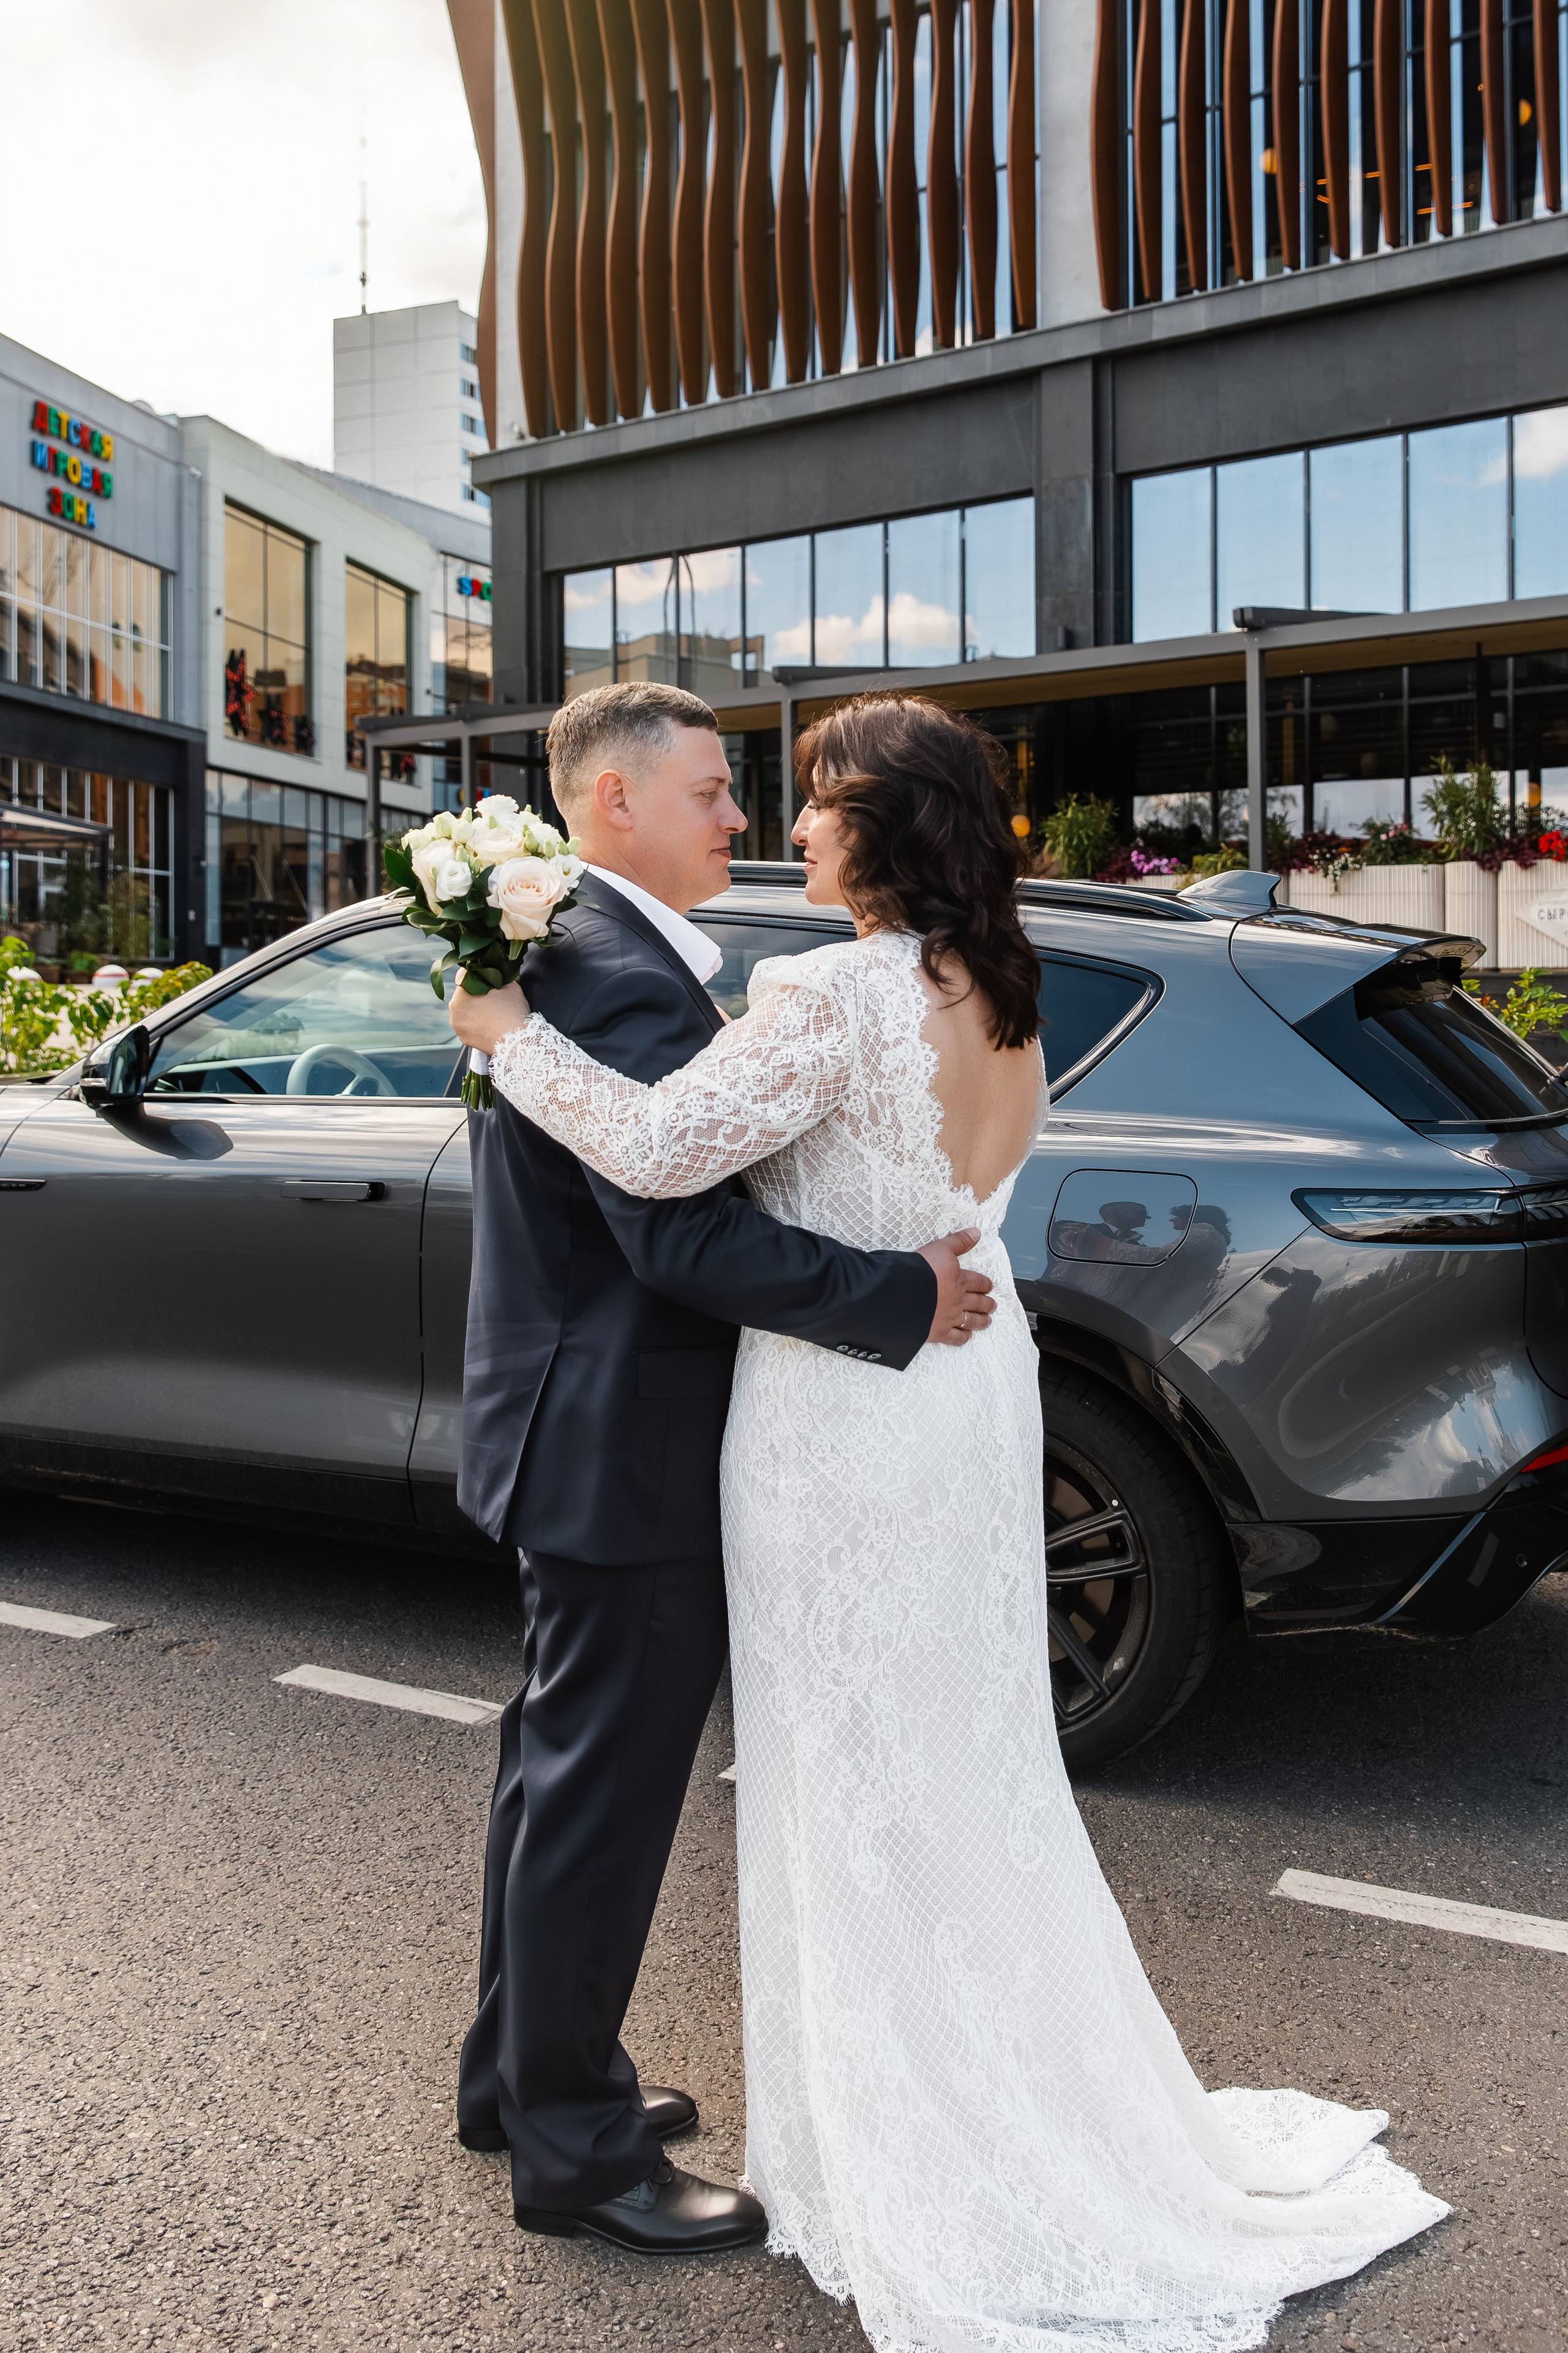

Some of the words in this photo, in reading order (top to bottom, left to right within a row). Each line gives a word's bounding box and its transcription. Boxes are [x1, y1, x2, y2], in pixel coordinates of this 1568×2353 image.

[32, 400, 115, 463] ДЕТСКАЯ
[32, 439, 113, 499] ИГРОВАЯ
[48, 486, 97, 529] ЗОНА
[1537, 908, 1568, 921] СЫР
